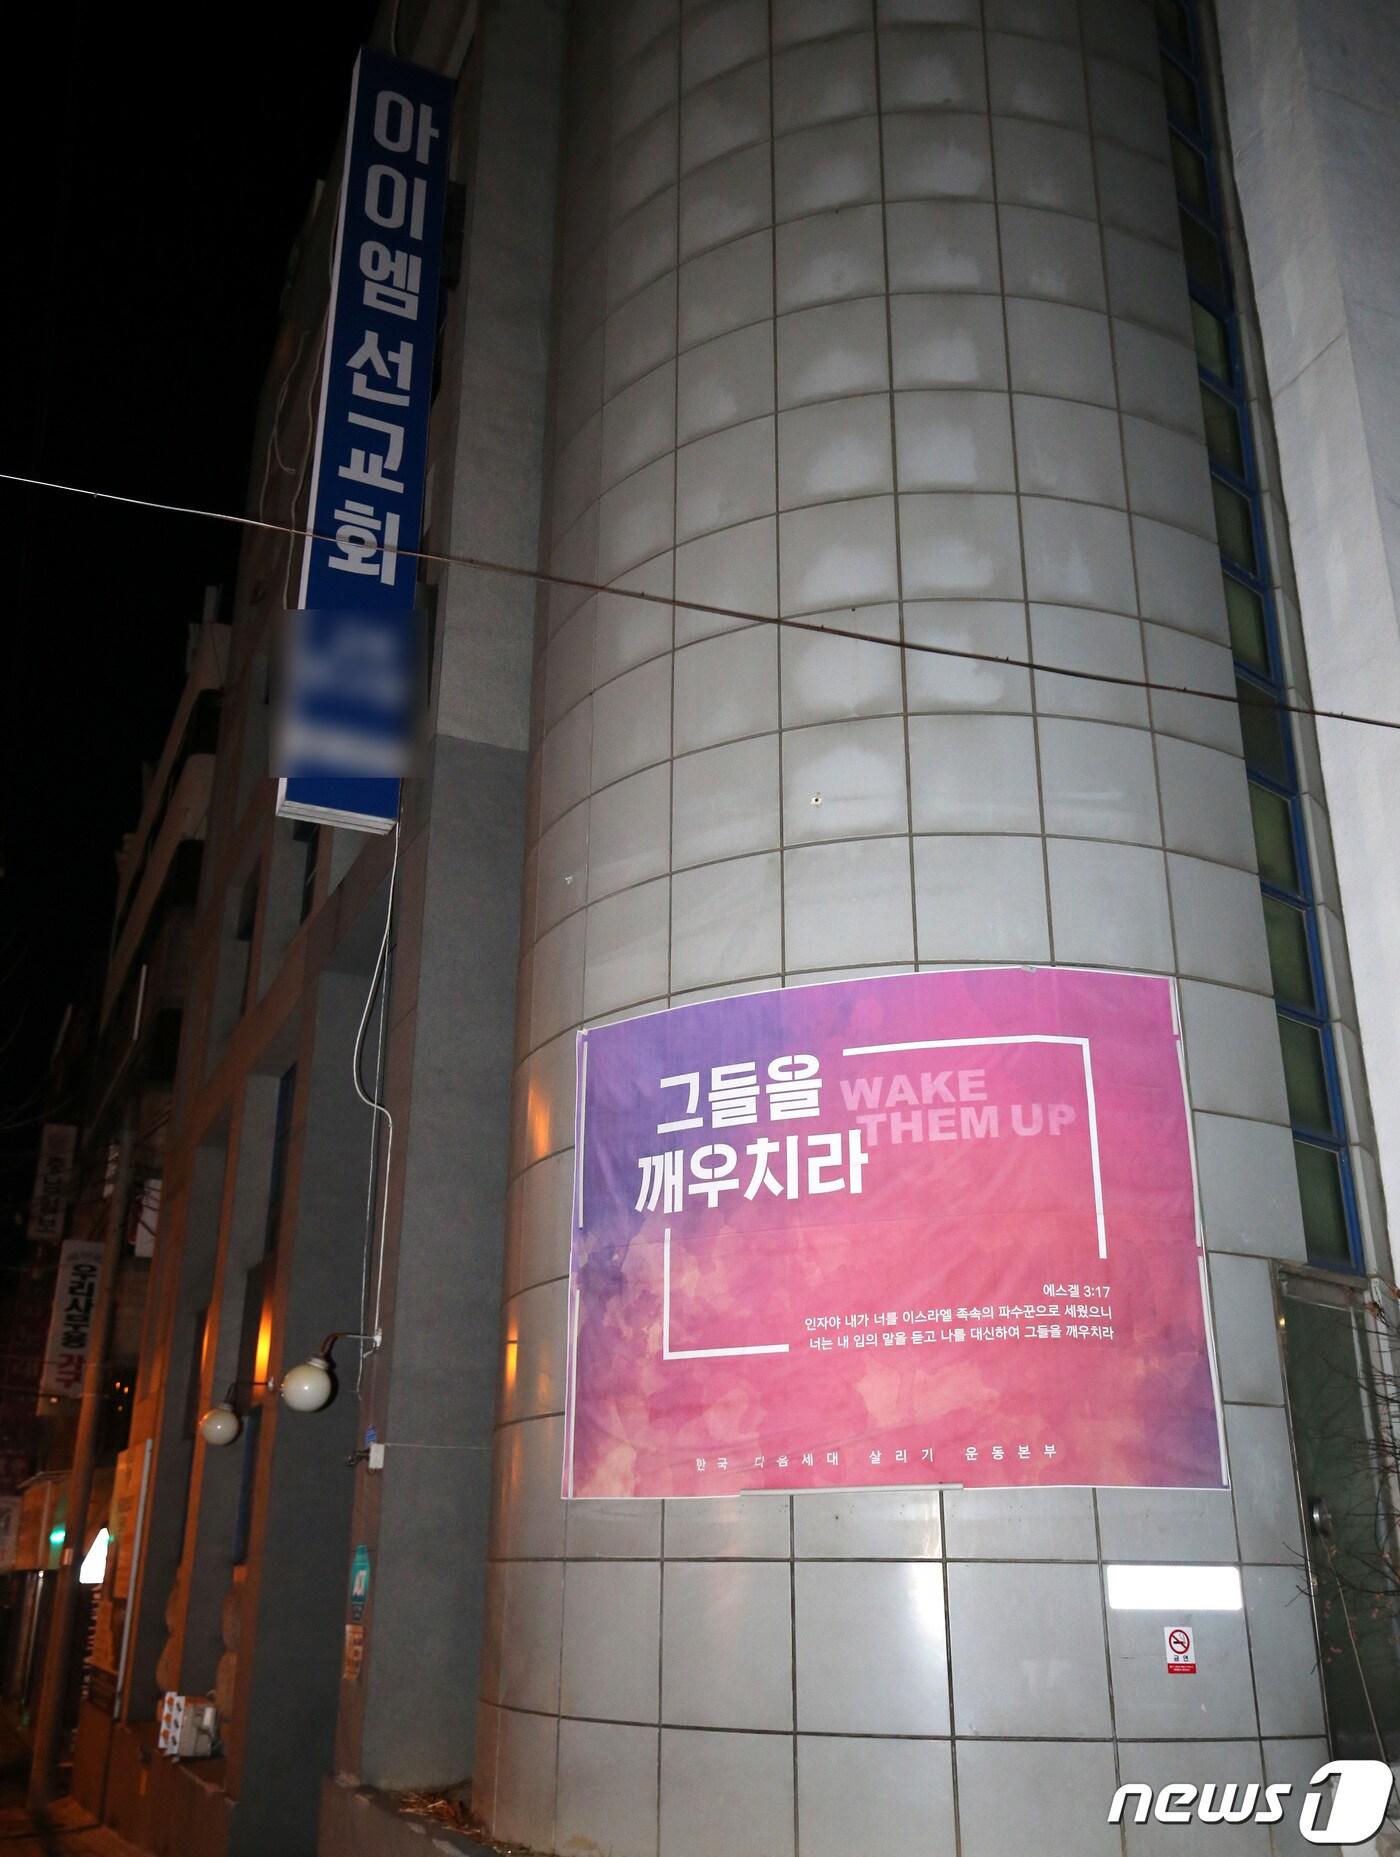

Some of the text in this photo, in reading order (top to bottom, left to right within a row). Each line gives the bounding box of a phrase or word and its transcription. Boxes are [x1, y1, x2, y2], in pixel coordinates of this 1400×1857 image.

[327, 88, 440, 586] 아이엠선교회
[656, 1053, 823, 1135] 그들을
[839, 1067, 988, 1112] WAKE
[856, 1103, 1077, 1147] THEM UP
[634, 1129, 870, 1215] 깨우치라
[1042, 1283, 1111, 1298] 에스겔 3:17
[804, 1304, 1112, 1331] 인자야 내가 너를 이스라엘 족속의 파수꾼으로 세웠으니
[809, 1324, 1115, 1351] 너는 내 입의 말을 듣고 나를 대신하여 그들을 깨우치라
